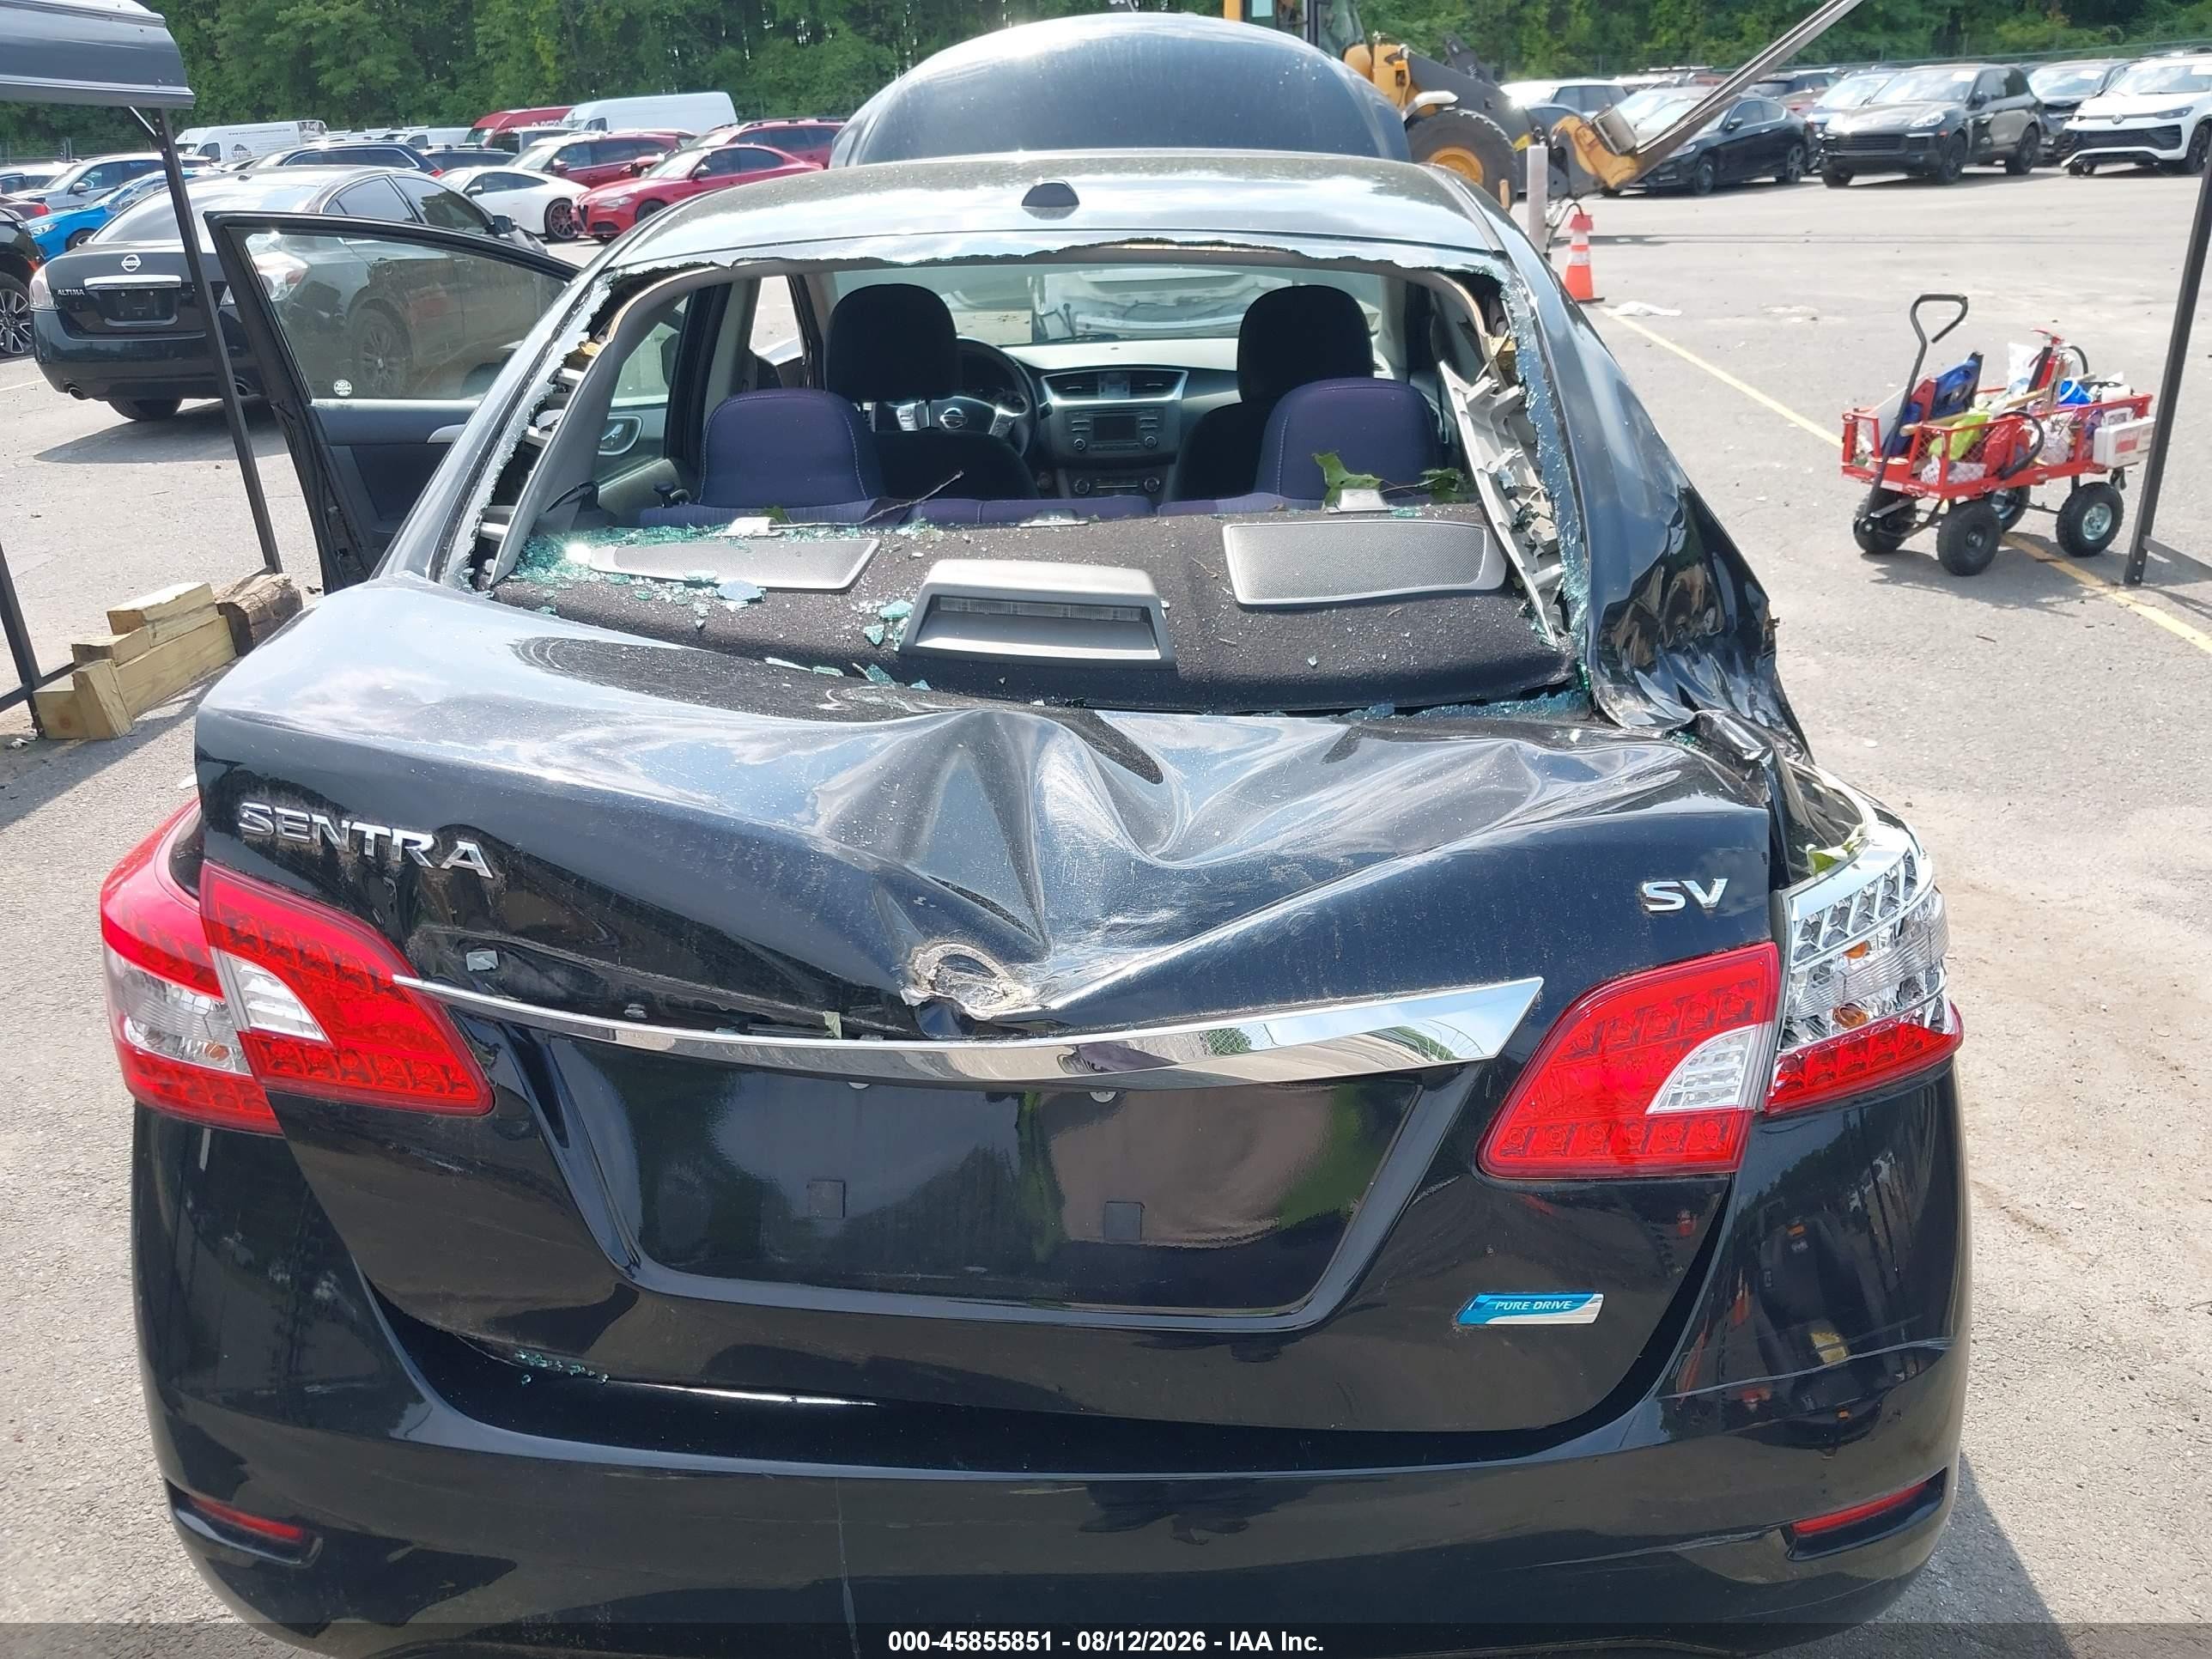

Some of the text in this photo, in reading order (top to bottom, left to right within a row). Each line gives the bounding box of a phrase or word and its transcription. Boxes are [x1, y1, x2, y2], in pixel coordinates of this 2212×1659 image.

[239, 801, 494, 879] SENTRA
[1642, 878, 1729, 912] SV
[1495, 1300, 1572, 1310] PURE DRIVE
